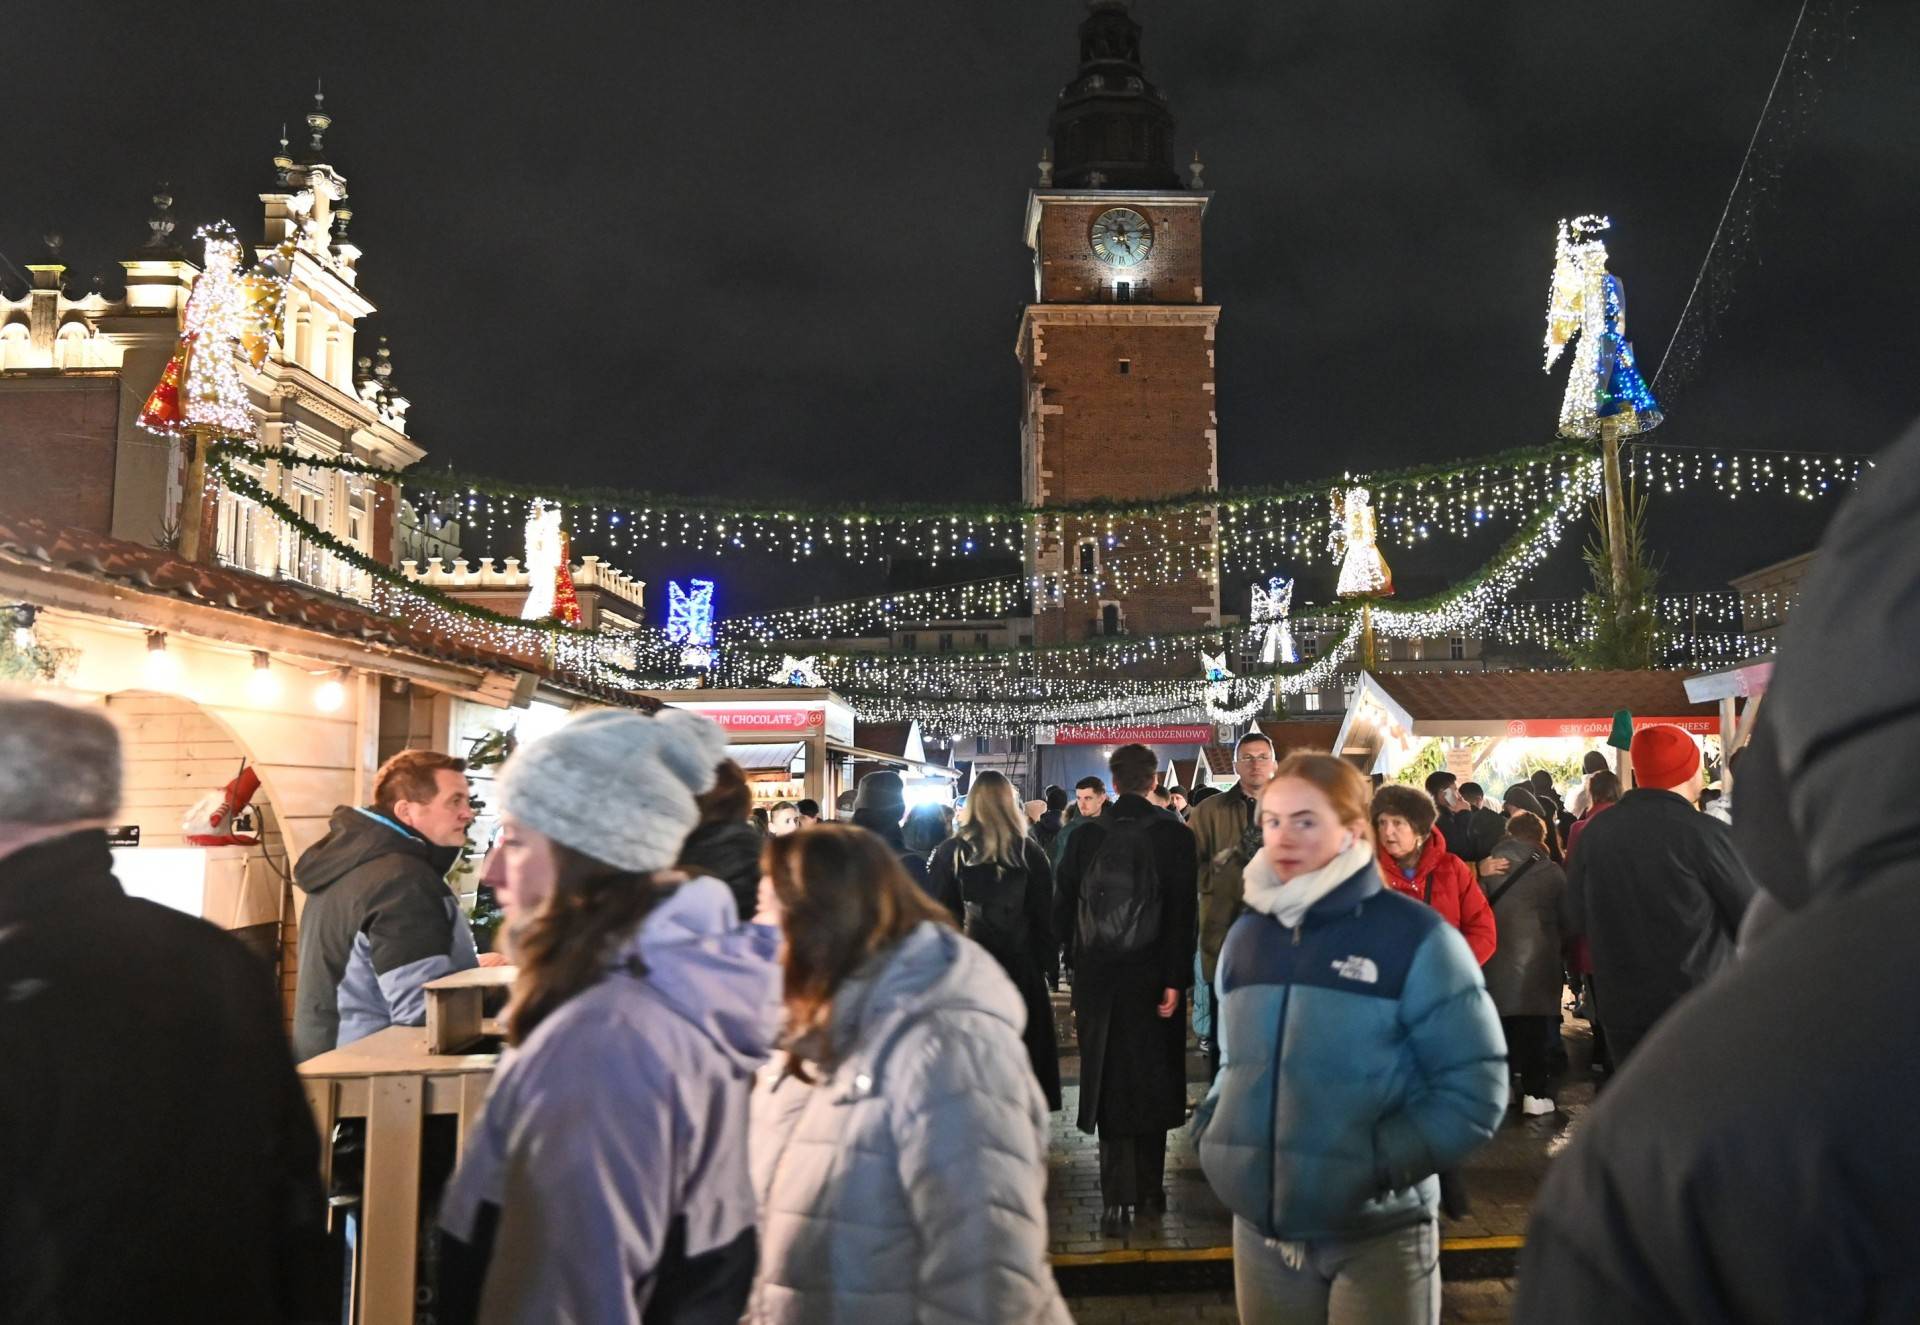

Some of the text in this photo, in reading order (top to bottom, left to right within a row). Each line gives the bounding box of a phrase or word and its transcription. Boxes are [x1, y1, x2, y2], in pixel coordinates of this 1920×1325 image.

[720, 714, 731, 725] IN
[733, 714, 792, 725] CHOCOLATE
[810, 713, 822, 723] 69
[1583, 722, 1613, 733] GÓRAL
[1062, 730, 1106, 741] JARMARK
